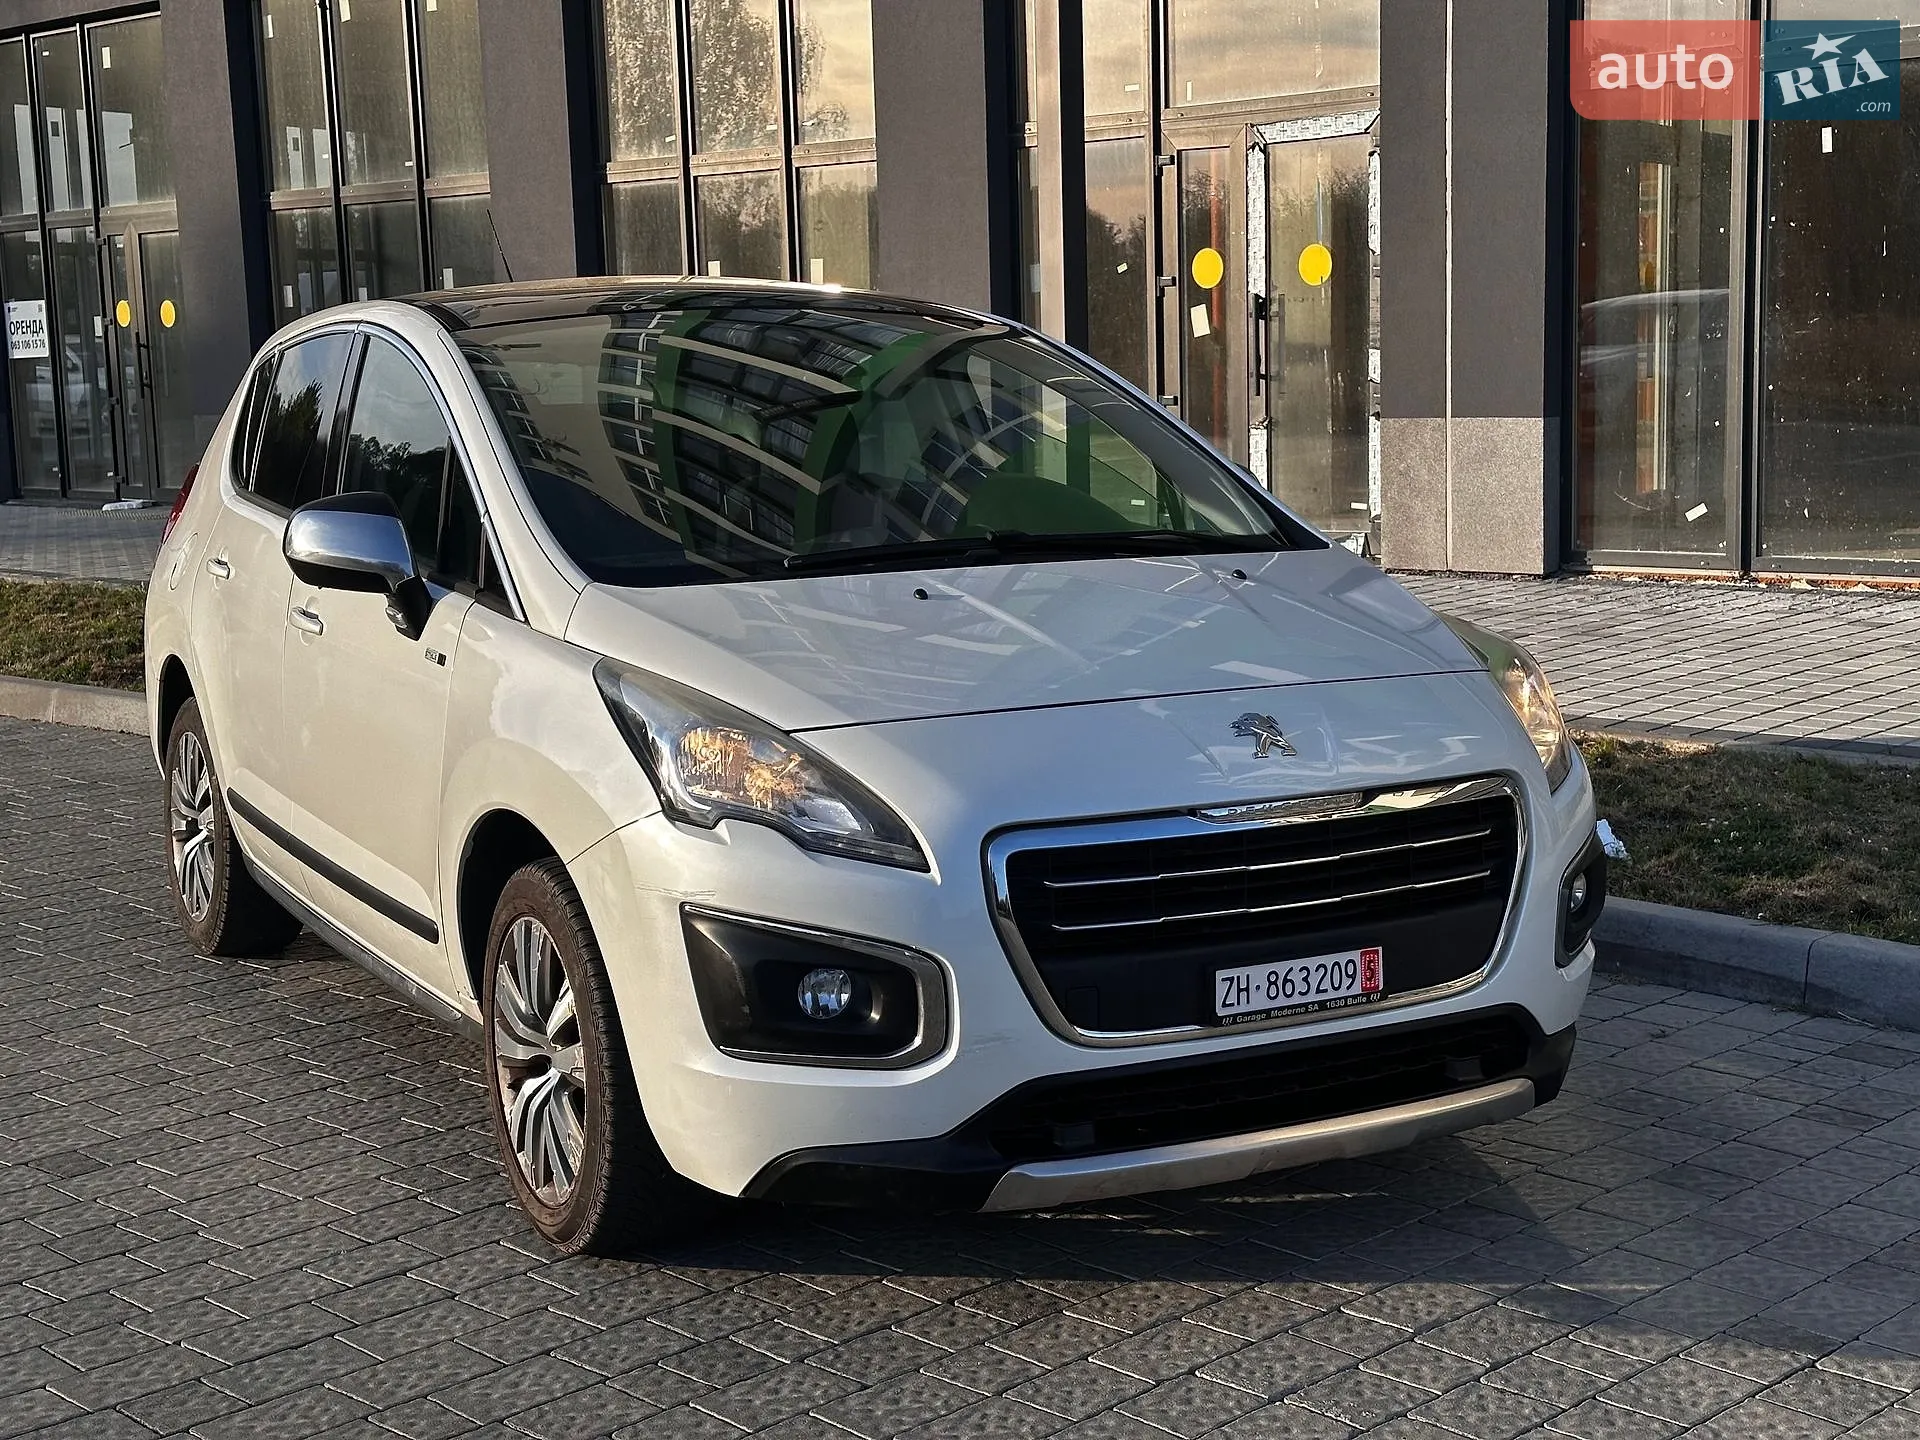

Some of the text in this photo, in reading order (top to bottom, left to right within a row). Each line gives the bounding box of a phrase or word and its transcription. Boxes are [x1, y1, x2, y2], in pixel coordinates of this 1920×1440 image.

[9, 319, 44, 338] ОРЕНДА
[1236, 1012, 1266, 1023] Garage
[1270, 1006, 1306, 1018] Moderne
[1307, 1003, 1319, 1012] SA
[1326, 999, 1346, 1009] 1630
